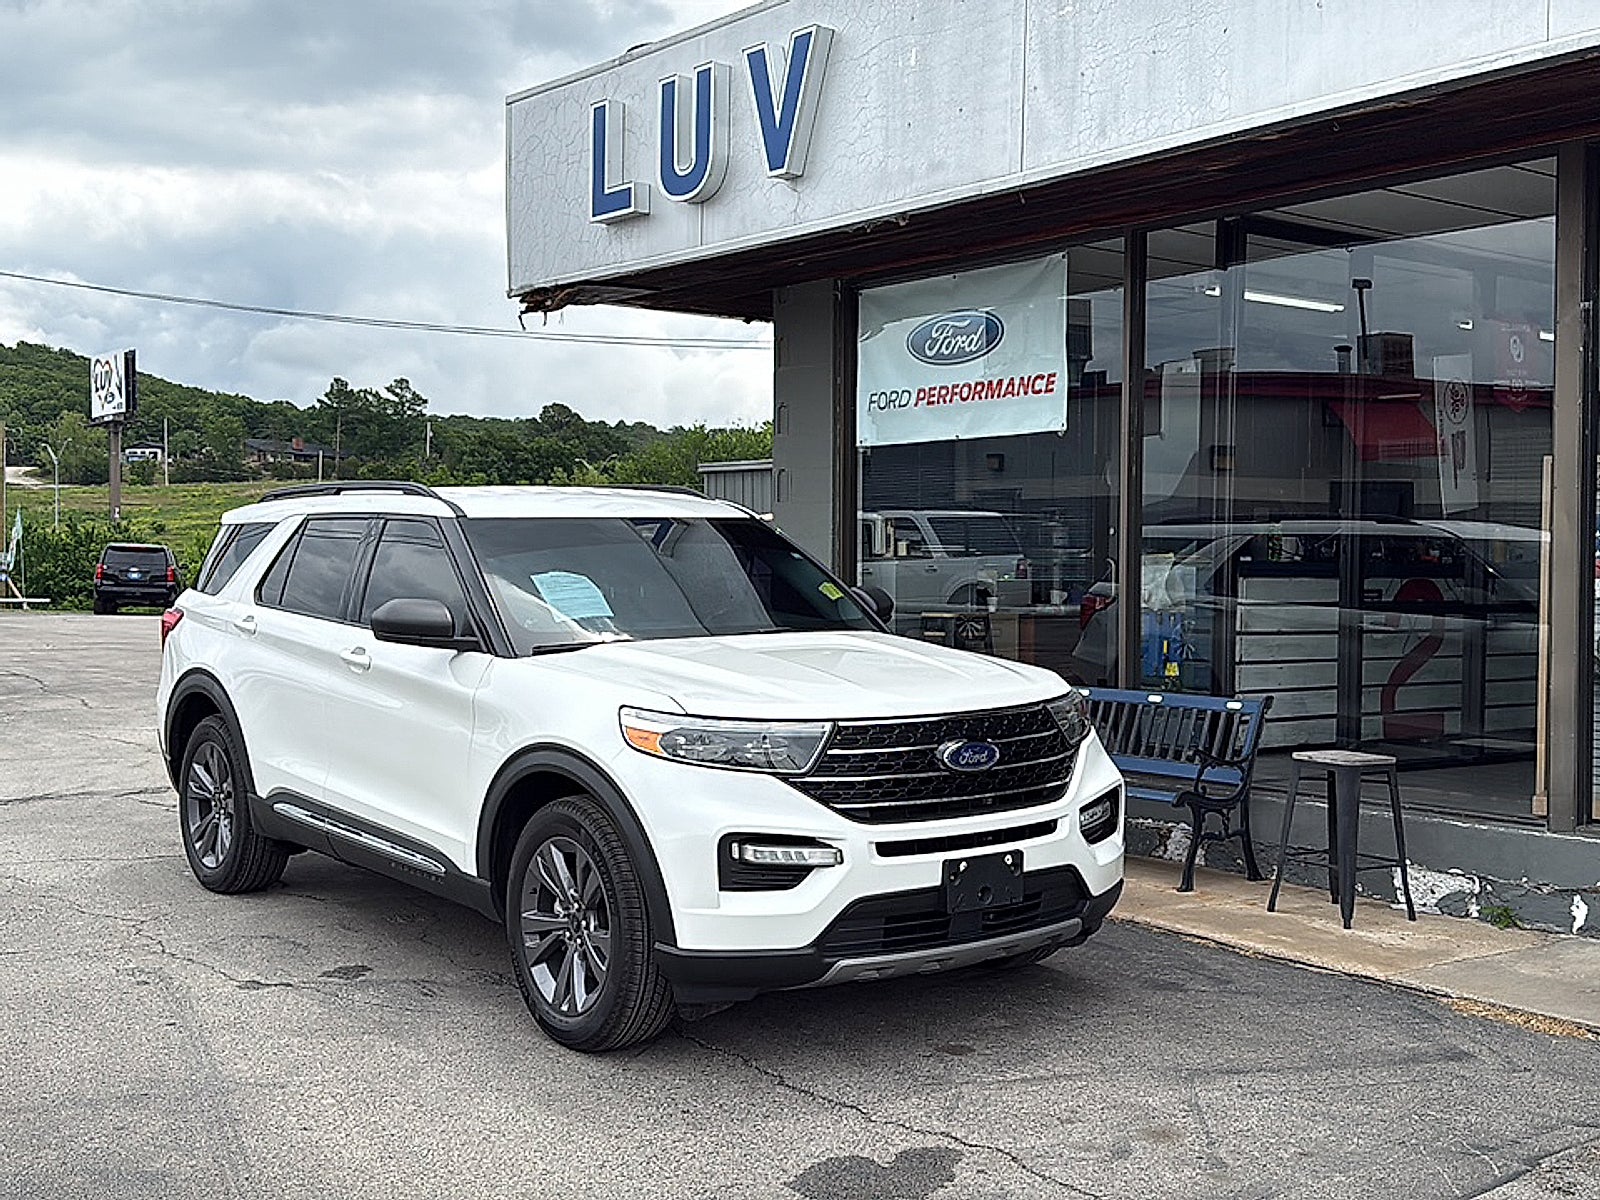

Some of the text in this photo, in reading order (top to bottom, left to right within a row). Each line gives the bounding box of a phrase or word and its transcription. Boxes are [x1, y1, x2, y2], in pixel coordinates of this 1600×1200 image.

[589, 24, 826, 222] LUV
[925, 319, 985, 356] Ford
[868, 372, 1057, 411] FORD PERFORMANCE
[959, 748, 988, 765] Ford
